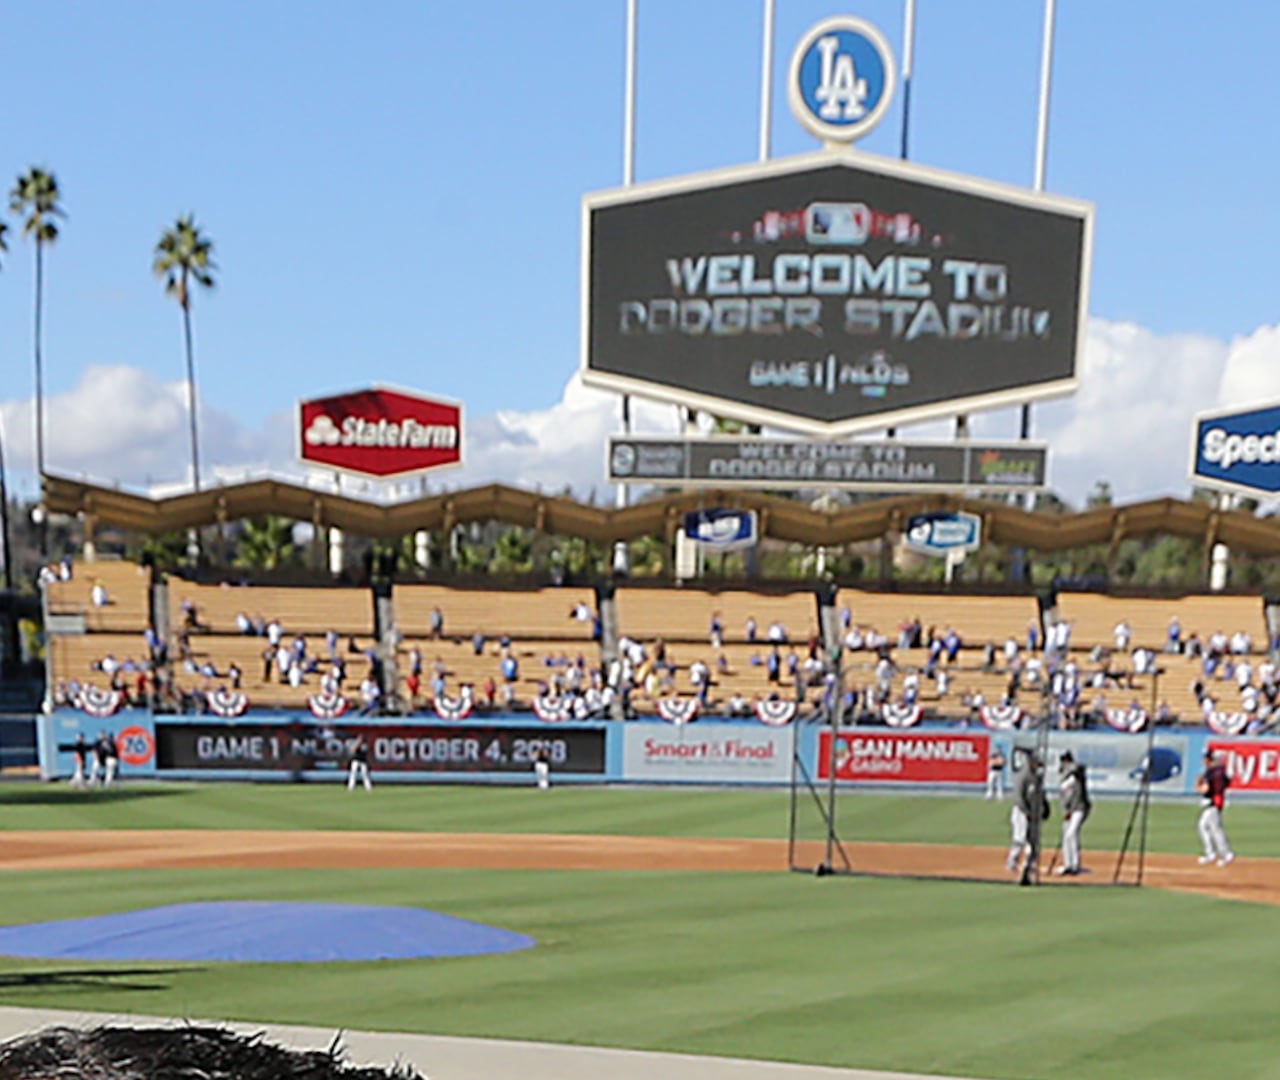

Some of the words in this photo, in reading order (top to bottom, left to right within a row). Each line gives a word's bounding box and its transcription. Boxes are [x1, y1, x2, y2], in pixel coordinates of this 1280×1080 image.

[814, 35, 867, 119] LA
[666, 253, 931, 297] WELCOME
[943, 258, 1008, 301] TO
[620, 298, 823, 337] DODGER
[749, 359, 811, 386] GAME
[814, 360, 822, 387] 1
[840, 362, 910, 385] NLDS
[739, 442, 867, 460] WELCOME
[709, 458, 816, 477] DODGER
[823, 461, 935, 479] STADIUM
[197, 736, 264, 760] GAME
[270, 736, 280, 759] 1
[374, 737, 480, 762] OCTOBER
[484, 739, 509, 763] 4,
[644, 737, 707, 758] Smart
[725, 739, 775, 759] Final
[851, 738, 894, 758] SAN
[896, 740, 980, 762] MANUEL
[851, 758, 903, 774] CASINO
